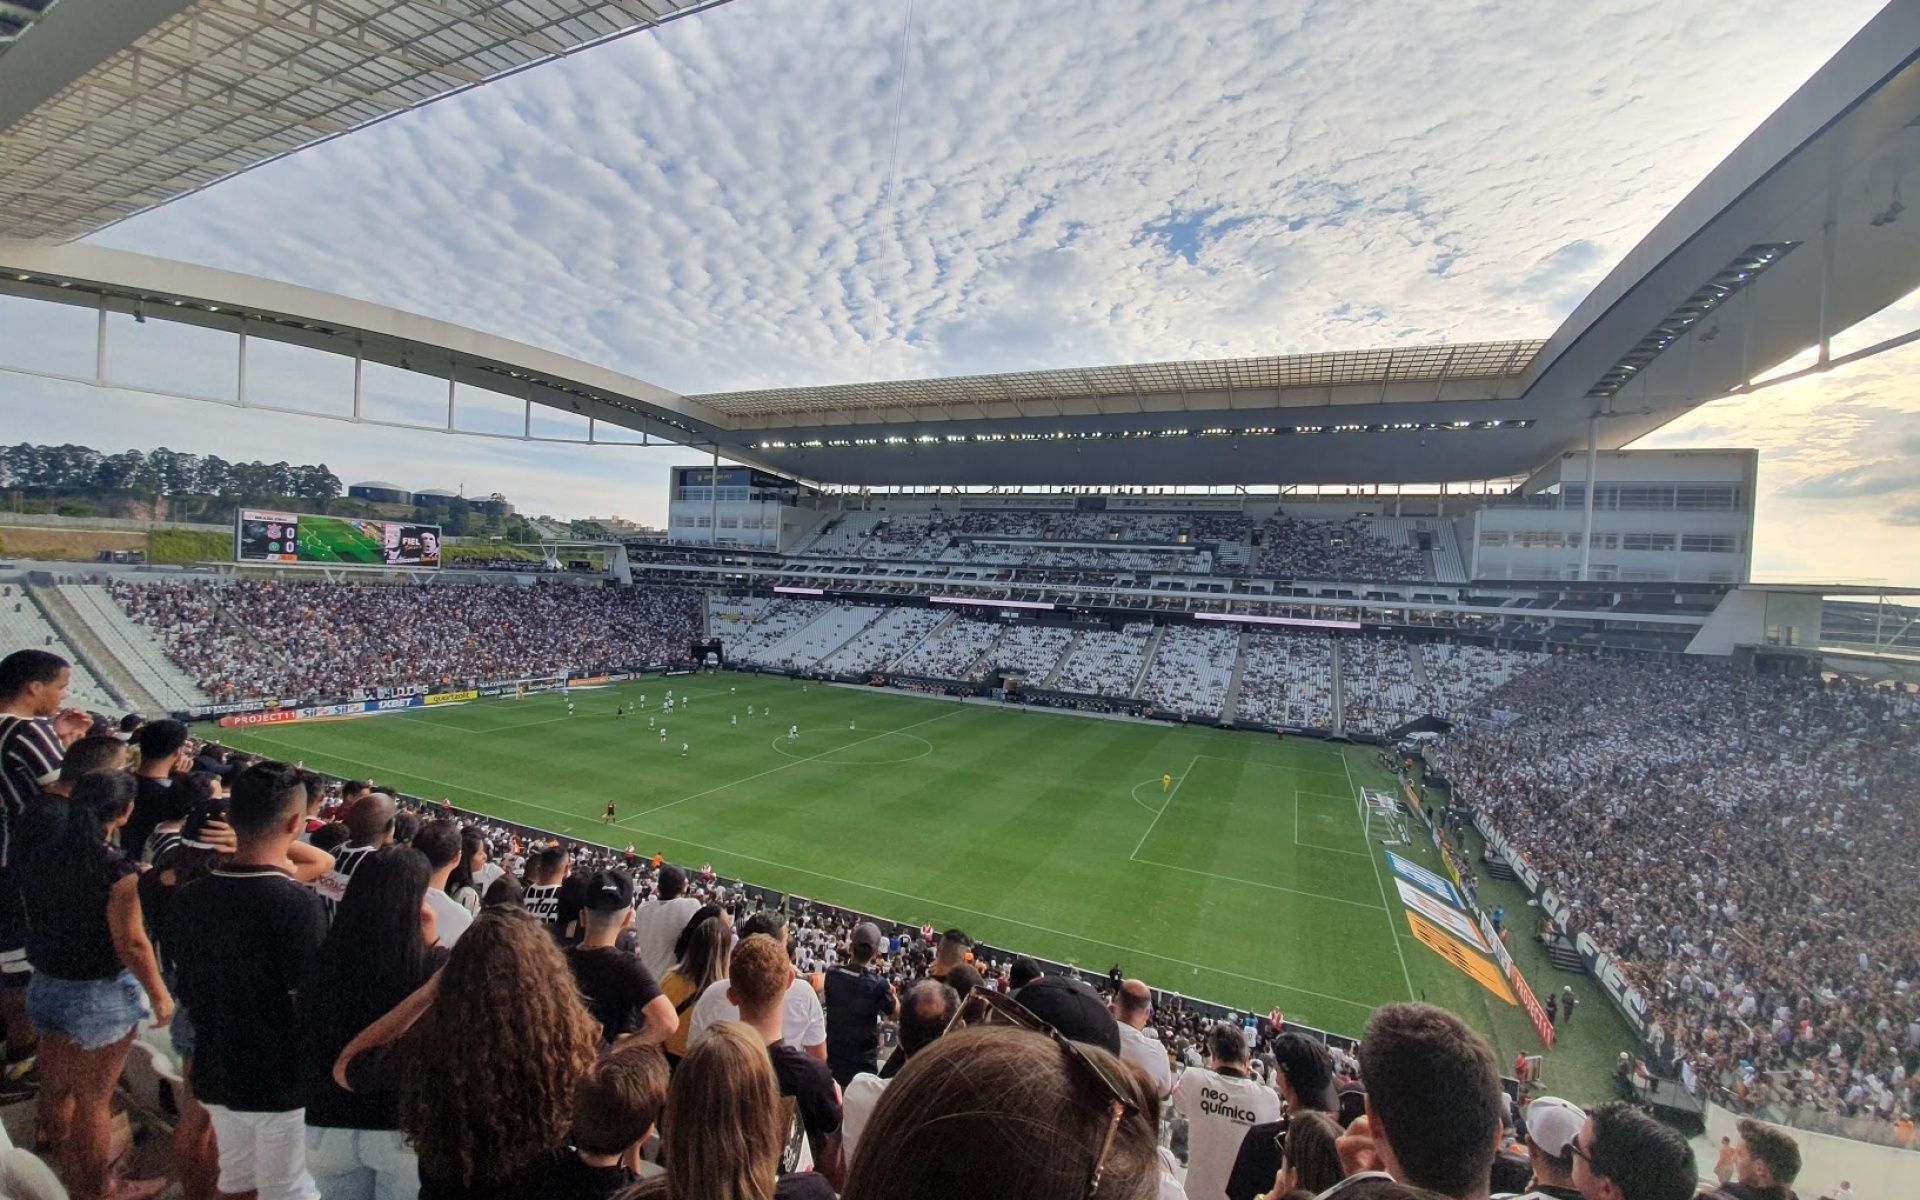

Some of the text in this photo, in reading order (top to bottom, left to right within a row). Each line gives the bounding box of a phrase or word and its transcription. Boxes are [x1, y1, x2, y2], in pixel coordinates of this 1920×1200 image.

[286, 527, 295, 539] 0
[285, 541, 295, 553] 0
[402, 537, 421, 546] FIEL
[1201, 1087, 1229, 1103] neo
[1200, 1100, 1256, 1123] química
